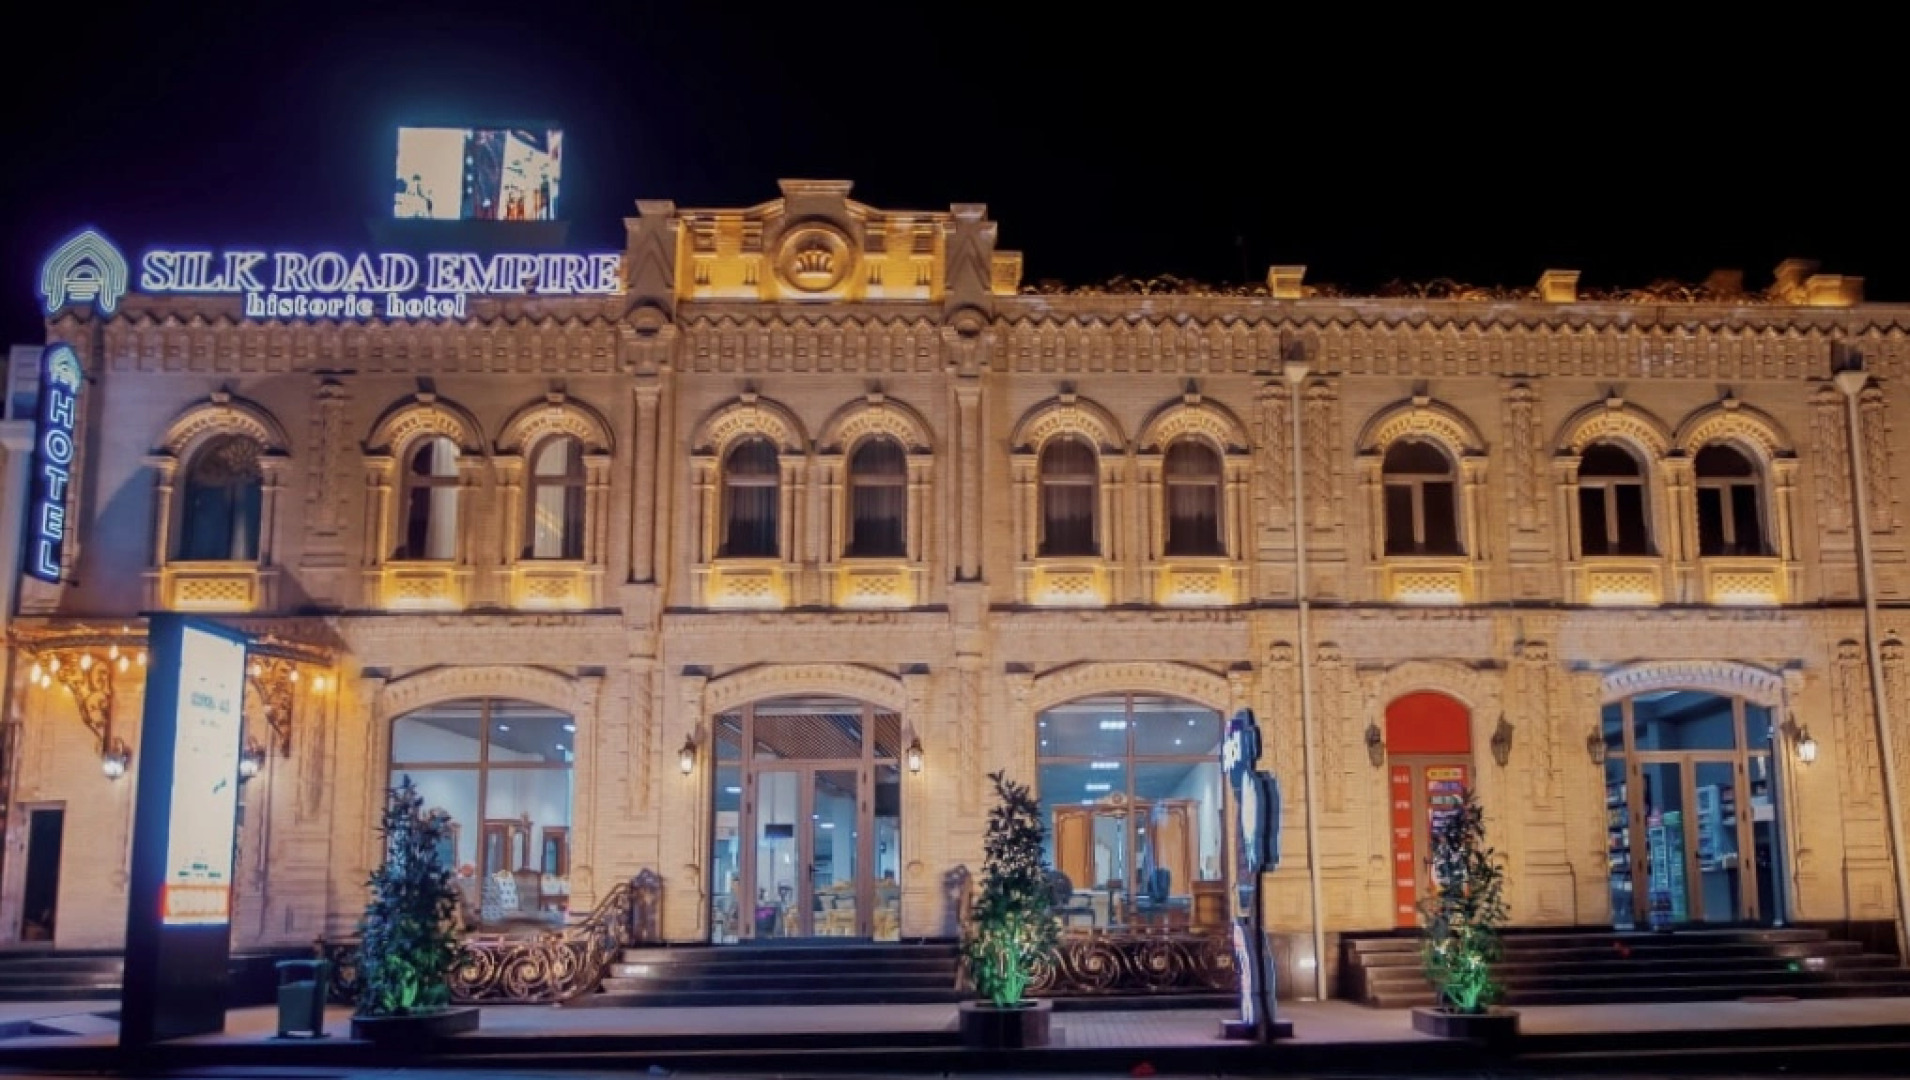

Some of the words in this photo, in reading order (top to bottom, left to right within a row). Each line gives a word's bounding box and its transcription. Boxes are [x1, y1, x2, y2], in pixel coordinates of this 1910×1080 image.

[142, 249, 264, 292] SILK
[274, 251, 420, 293] ROAD
[428, 252, 621, 294] EMPIRE
[246, 292, 374, 317] historic
[386, 293, 466, 318] hotel
[40, 390, 76, 576] HOTEL
